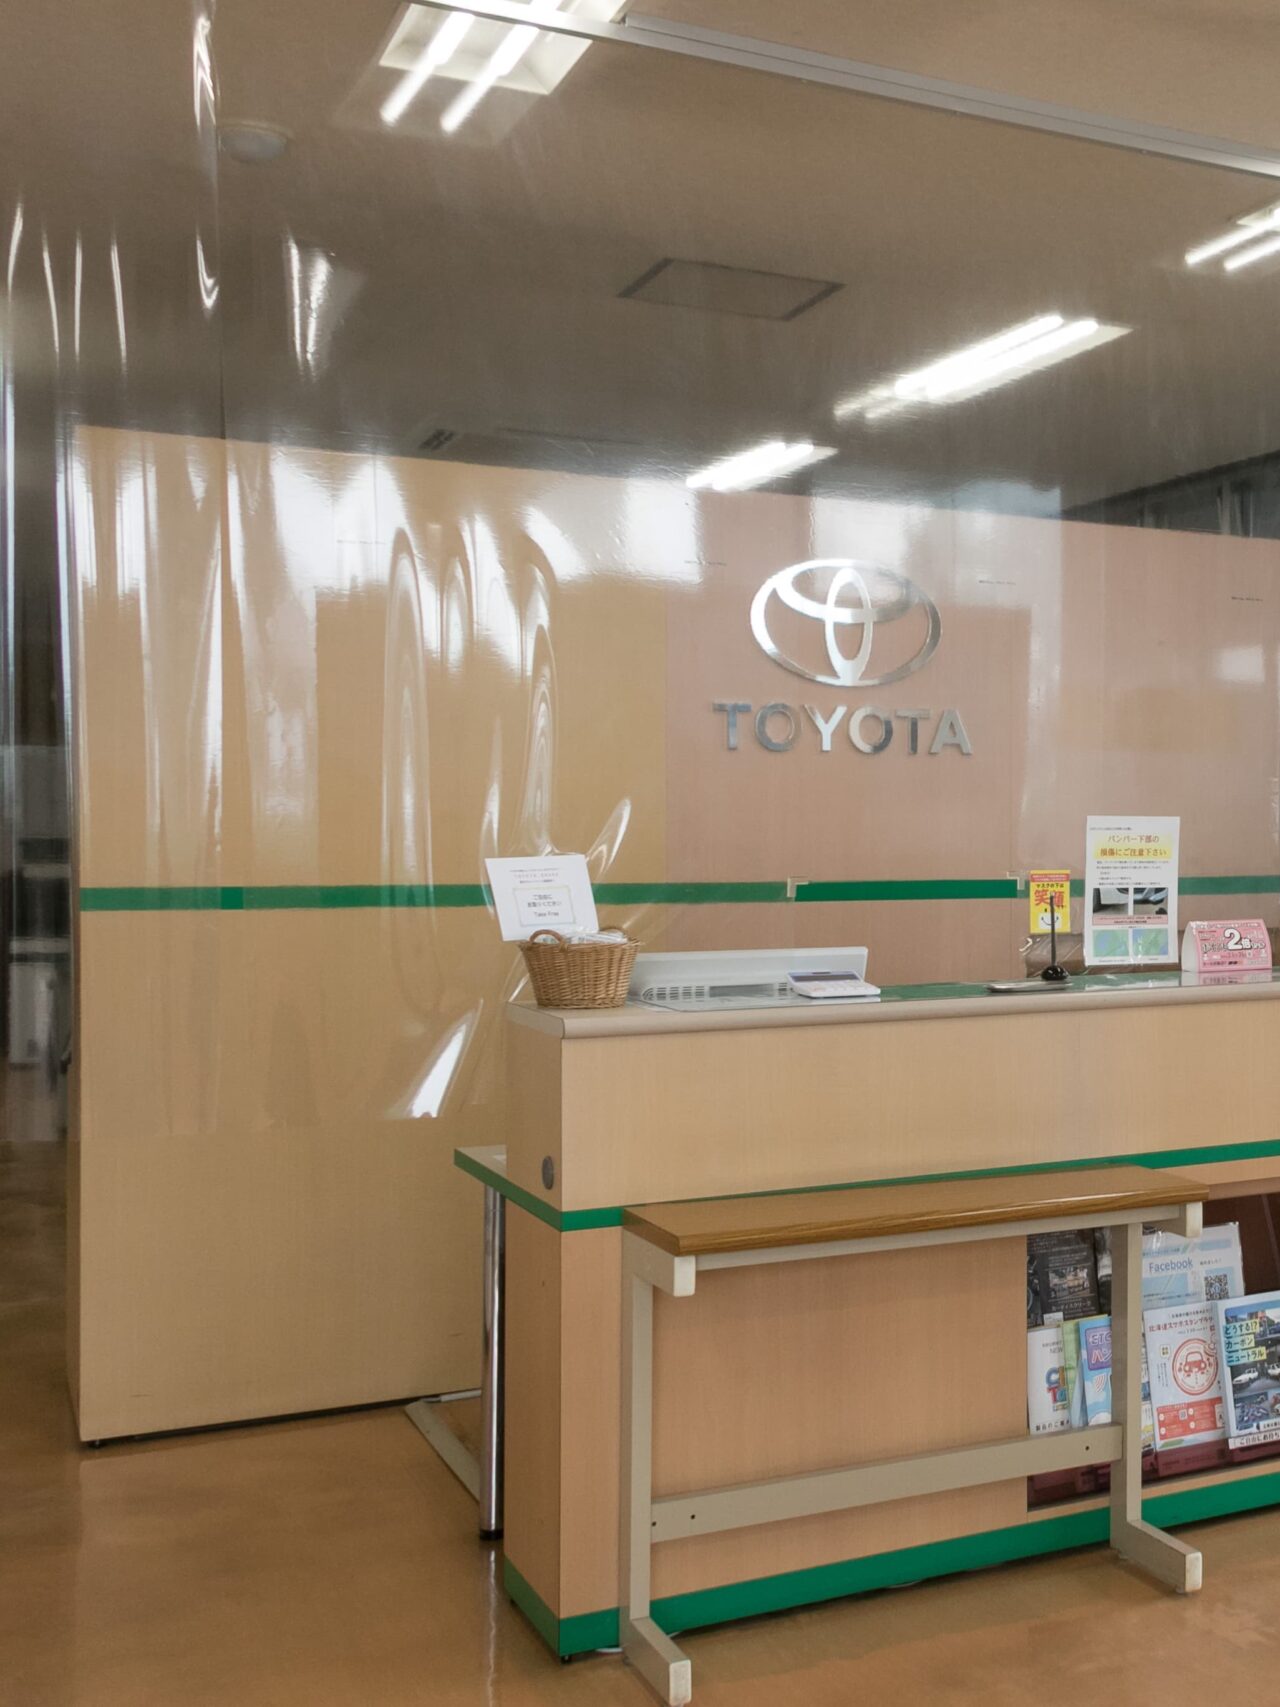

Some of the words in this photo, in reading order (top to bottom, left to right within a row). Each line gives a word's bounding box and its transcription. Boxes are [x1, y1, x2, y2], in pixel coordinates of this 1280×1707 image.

[712, 699, 973, 756] TOYOTA
[1148, 1257, 1194, 1274] Facebook
[1227, 1349, 1265, 1363] ニュートラル
